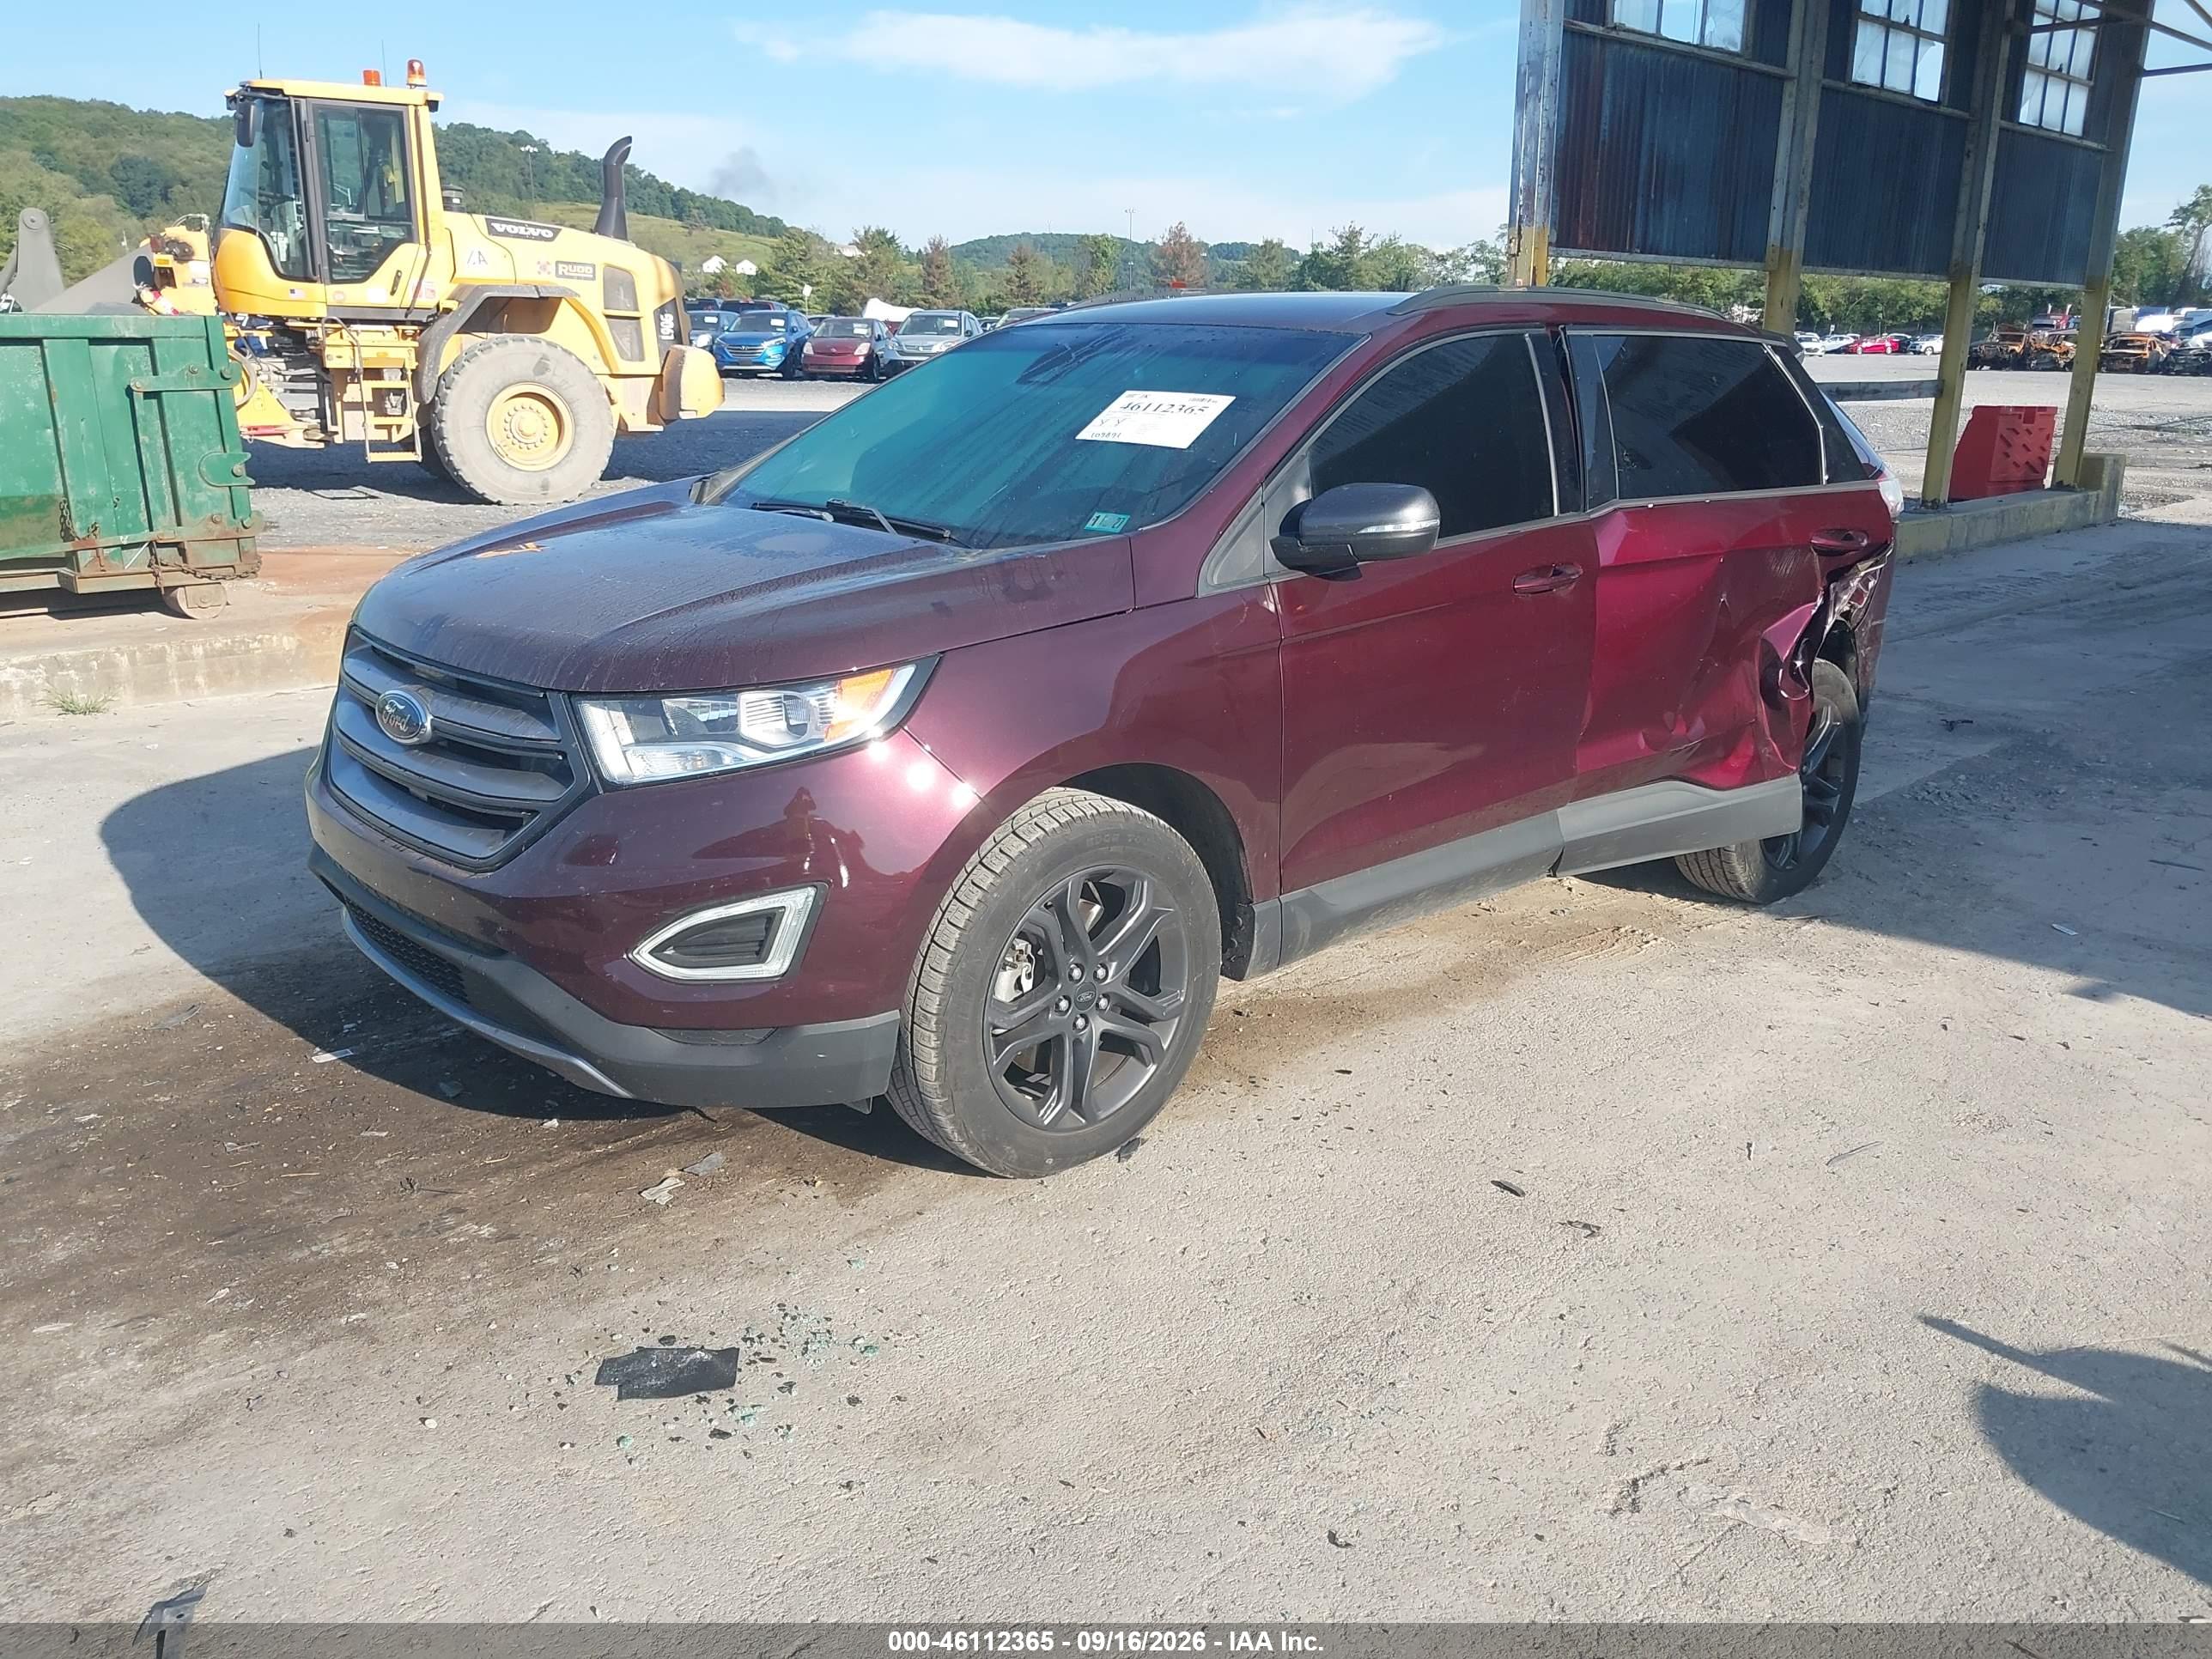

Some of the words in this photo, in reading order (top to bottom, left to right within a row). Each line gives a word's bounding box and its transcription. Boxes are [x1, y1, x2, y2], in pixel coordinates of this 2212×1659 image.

[491, 222, 554, 239] VOLVO
[1120, 402, 1210, 416] 46112365
[382, 699, 411, 732] Ford
